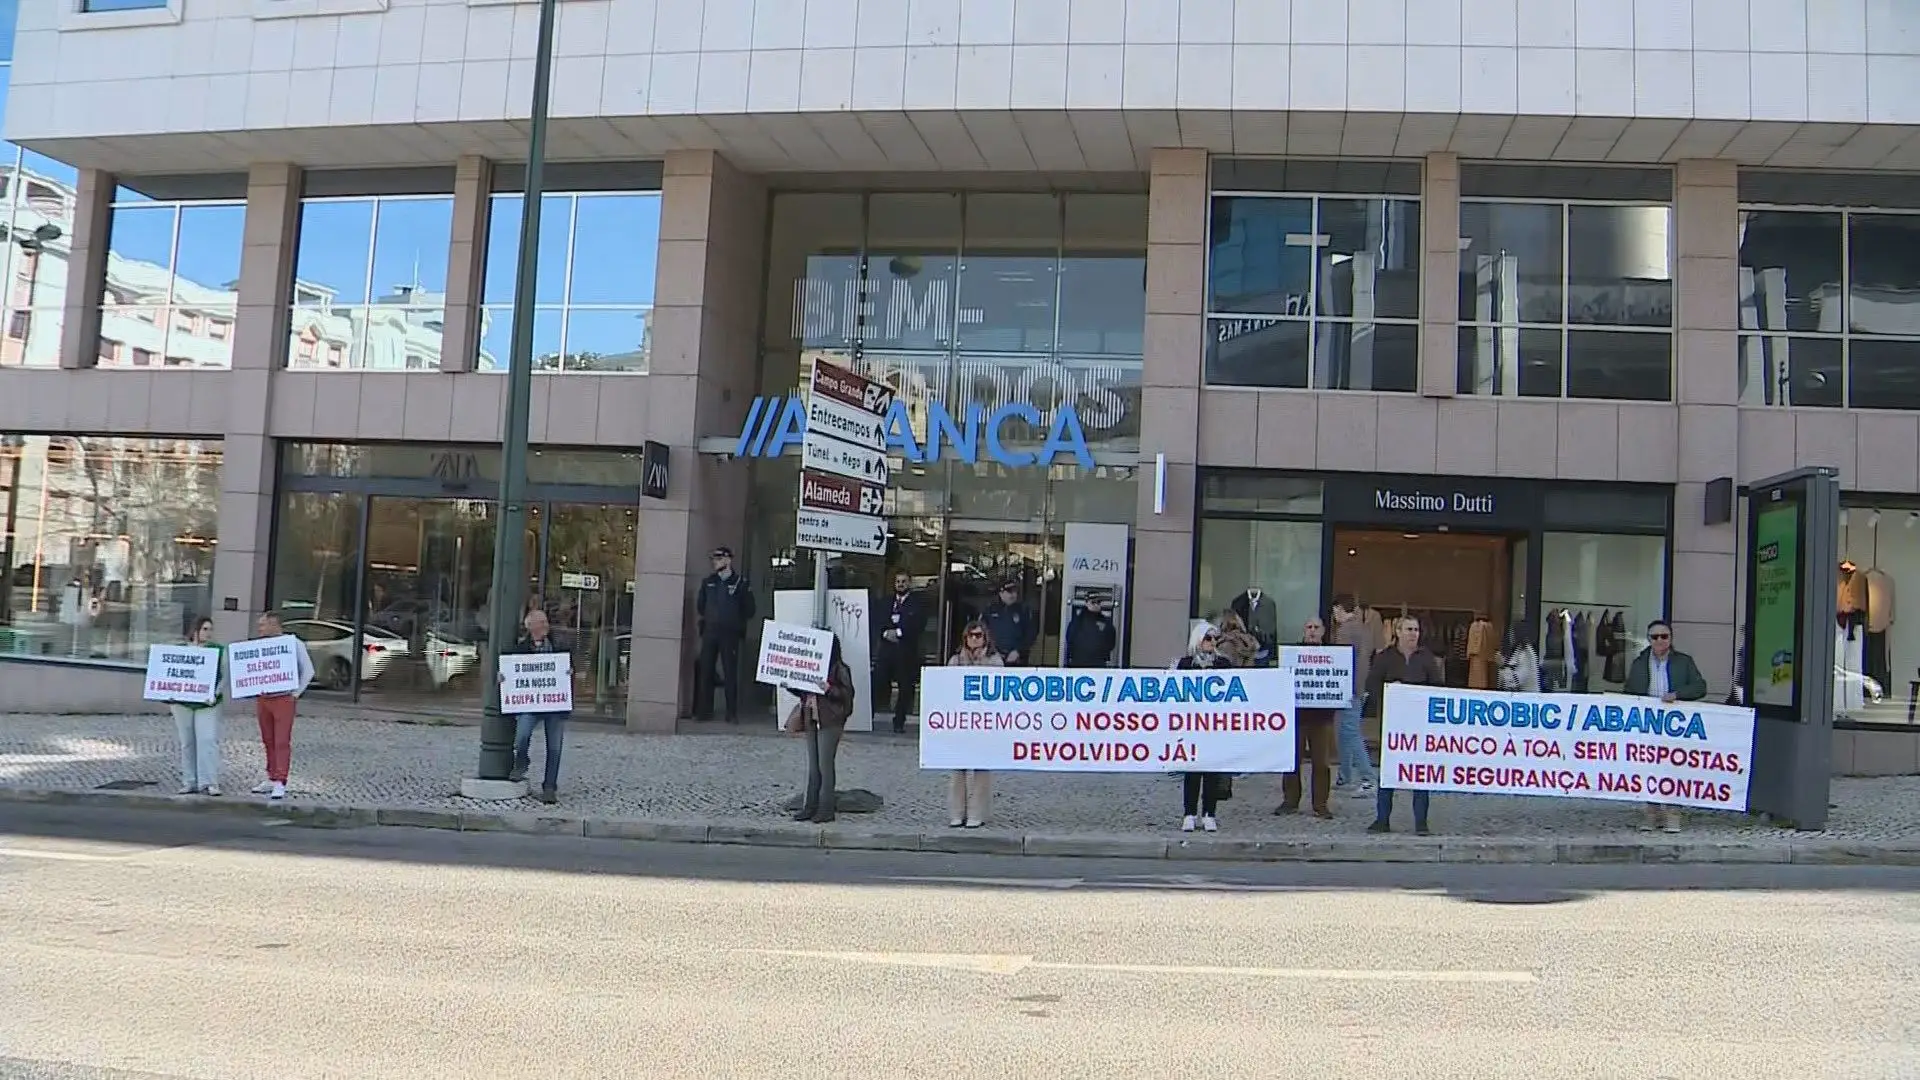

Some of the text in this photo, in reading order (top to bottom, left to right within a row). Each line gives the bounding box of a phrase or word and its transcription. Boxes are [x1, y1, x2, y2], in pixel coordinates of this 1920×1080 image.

[816, 370, 838, 390] Campo
[811, 404, 870, 438] Entrecampos
[807, 442, 860, 469] Túnel Rego
[804, 480, 850, 506] Alameda
[1375, 490, 1493, 513] Massimo Dutti
[1092, 559, 1119, 572] 24h
[162, 653, 205, 666] SEGURANÇA
[234, 648, 260, 661] ROUBO
[522, 662, 556, 672] DINHEIRO
[516, 678, 529, 689] ERA
[963, 675, 1096, 702] EUROBIC
[1116, 676, 1248, 703] ABANCA
[511, 693, 534, 705] CULPA
[928, 711, 1287, 732] QUEREMOS O NOSSO DINHEIRO
[1427, 697, 1561, 730] EUROBIC
[1582, 705, 1707, 740] ABANCA
[1013, 737, 1197, 763] DEVOLVIDO JÁ!
[1387, 732, 1745, 776] UM BANCO À TOA, SEM RESPOSTAS,
[1398, 764, 1731, 801] NEM SEGURANÇA NAS CONTAS
